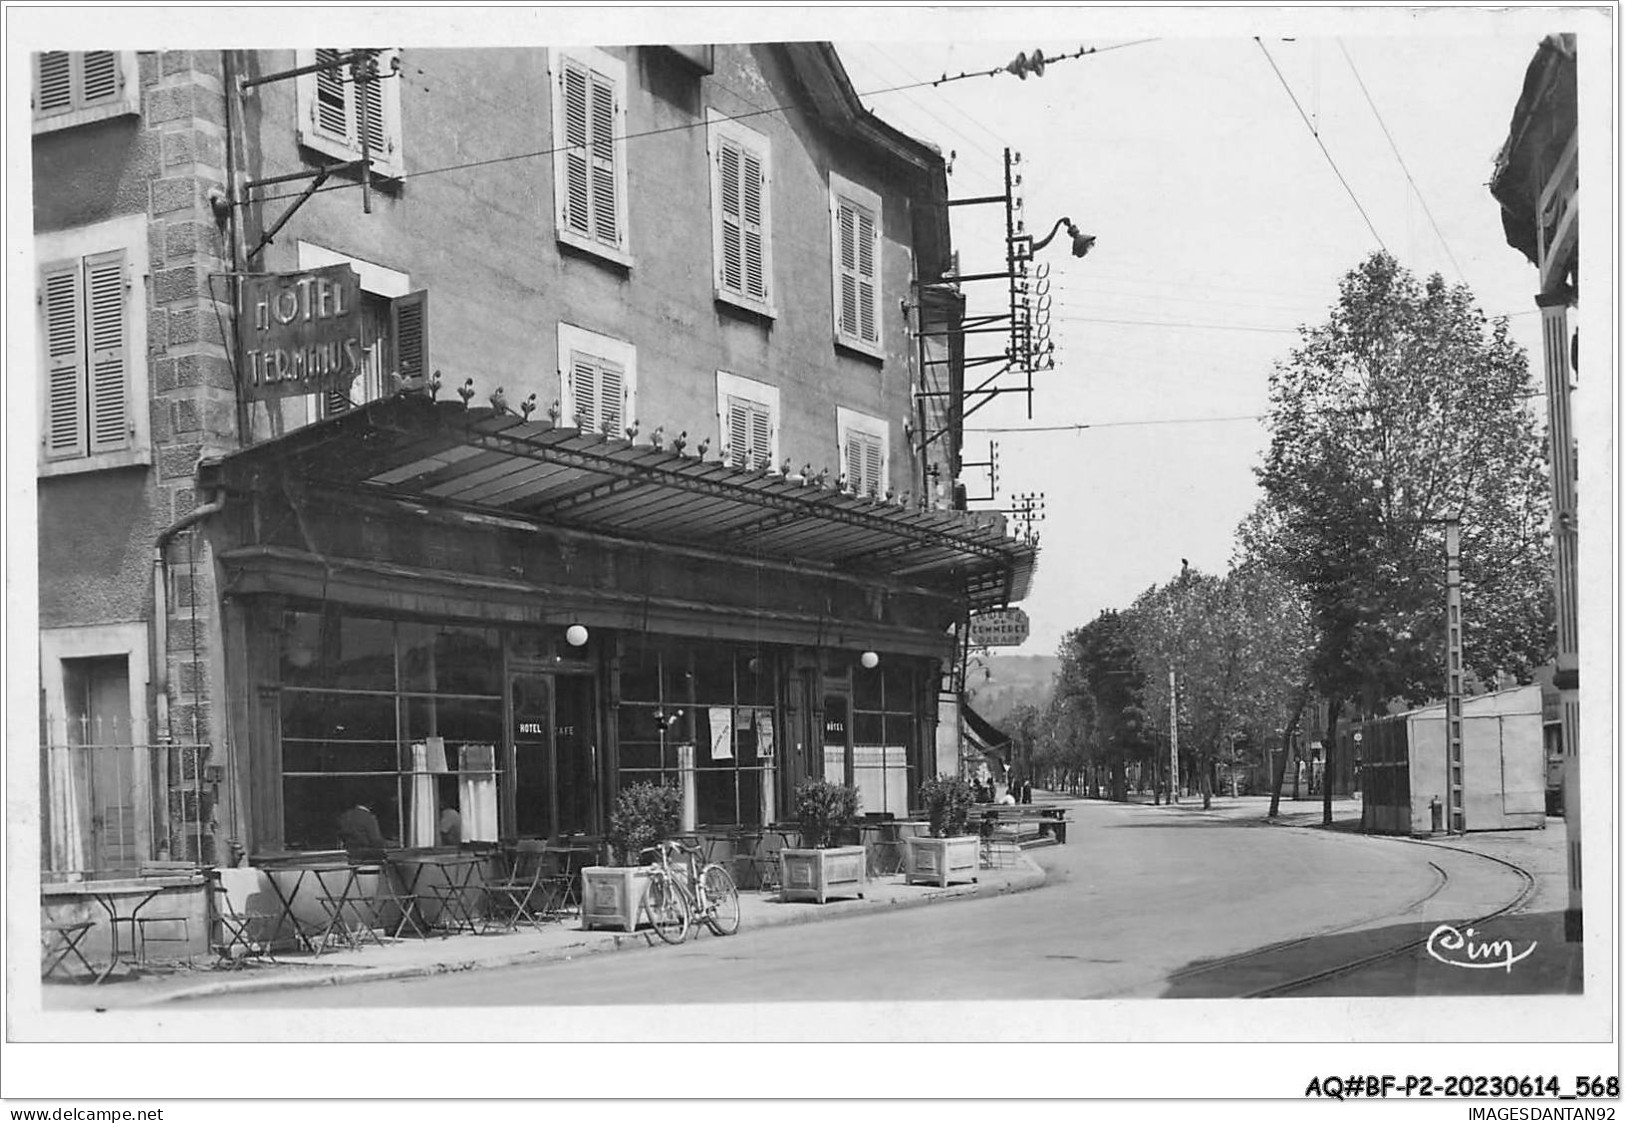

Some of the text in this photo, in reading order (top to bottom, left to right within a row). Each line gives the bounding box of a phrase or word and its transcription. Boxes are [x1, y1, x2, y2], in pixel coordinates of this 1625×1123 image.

[247, 338, 357, 383] TERMINUS
[972, 625, 1026, 634] COMMERCE
[519, 723, 542, 734] HOTEL
